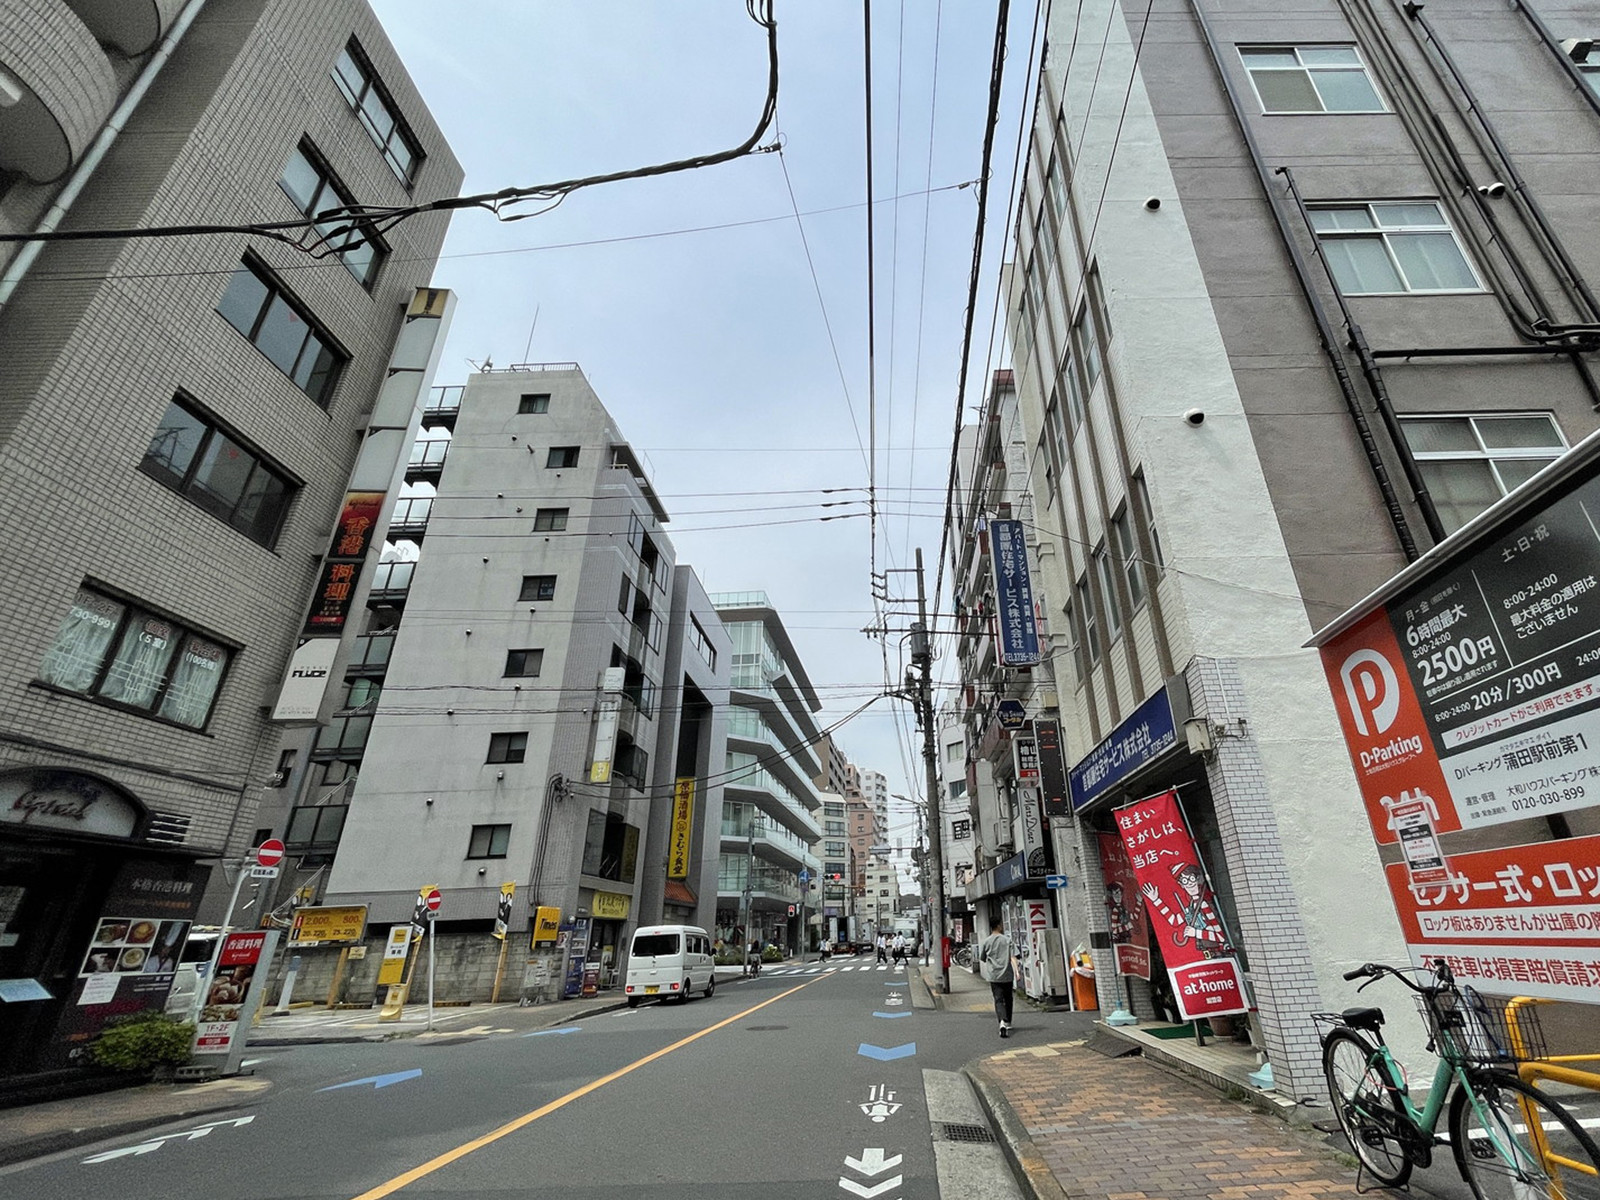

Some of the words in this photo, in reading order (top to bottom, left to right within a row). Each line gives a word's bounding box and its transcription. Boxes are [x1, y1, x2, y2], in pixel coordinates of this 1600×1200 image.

[998, 523, 1025, 649] 首都圏住宅サービス株式会社
[1503, 573, 1558, 609] 8:00-24:00
[1510, 575, 1598, 627] 最大料金の適用は
[1406, 603, 1468, 647] 6時間最大
[1516, 604, 1579, 639] ございません
[1412, 631, 1452, 659] 8:00-24:00
[1417, 635, 1497, 686] 2500円
[1575, 648, 1600, 666] 24:0
[1434, 702, 1471, 722] 8:00-24:00
[1454, 755, 1503, 780] Dパーキング
[1502, 732, 1589, 772] 蒲田駅前第1
[1506, 764, 1600, 797] 大和ハウスパーキング株
[1511, 785, 1586, 811] 0120-030-899
[1119, 807, 1157, 830] 住まい
[1125, 821, 1184, 849] さがしは、
[1132, 847, 1181, 870] 当店へ。
[1420, 955, 1600, 988] 不駐車は損害賠償請求
